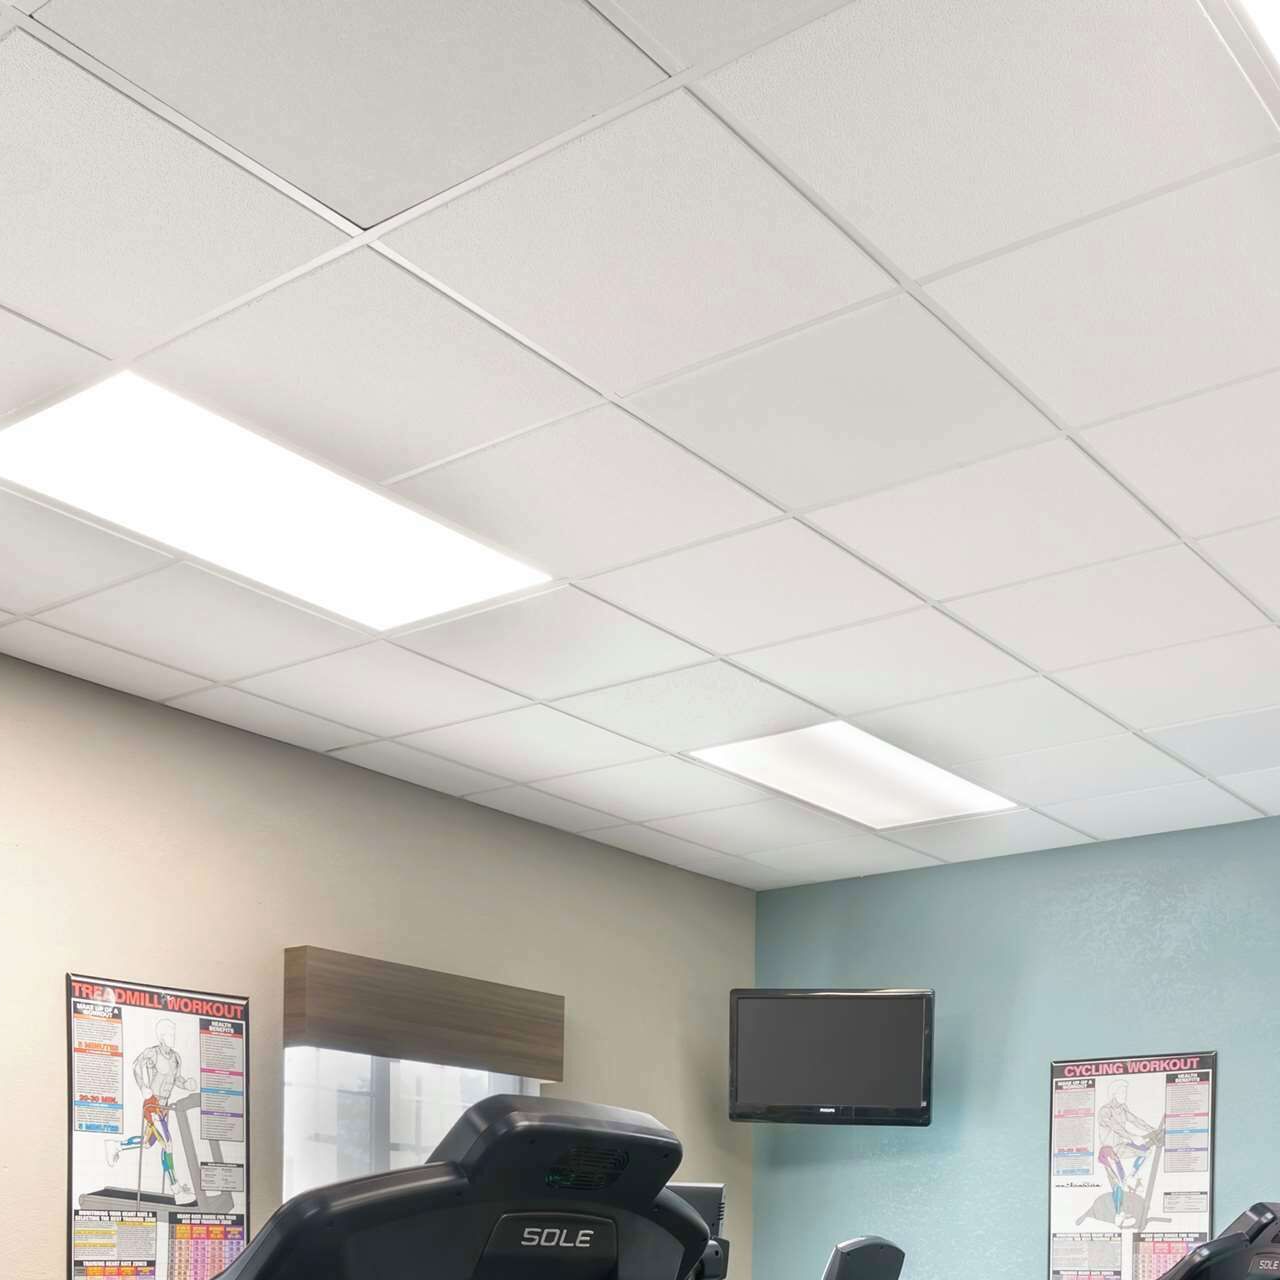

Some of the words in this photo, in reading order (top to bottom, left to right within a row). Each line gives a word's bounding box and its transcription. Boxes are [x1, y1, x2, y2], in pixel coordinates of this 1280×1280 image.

[72, 982, 163, 1009] TREADMILL
[167, 997, 244, 1020] WORKOUT
[1064, 1063, 1123, 1077] CYCLING
[1127, 1058, 1200, 1074] WORKOUT
[521, 1227, 594, 1247] SOLE
[1259, 1260, 1280, 1270] SOLE
